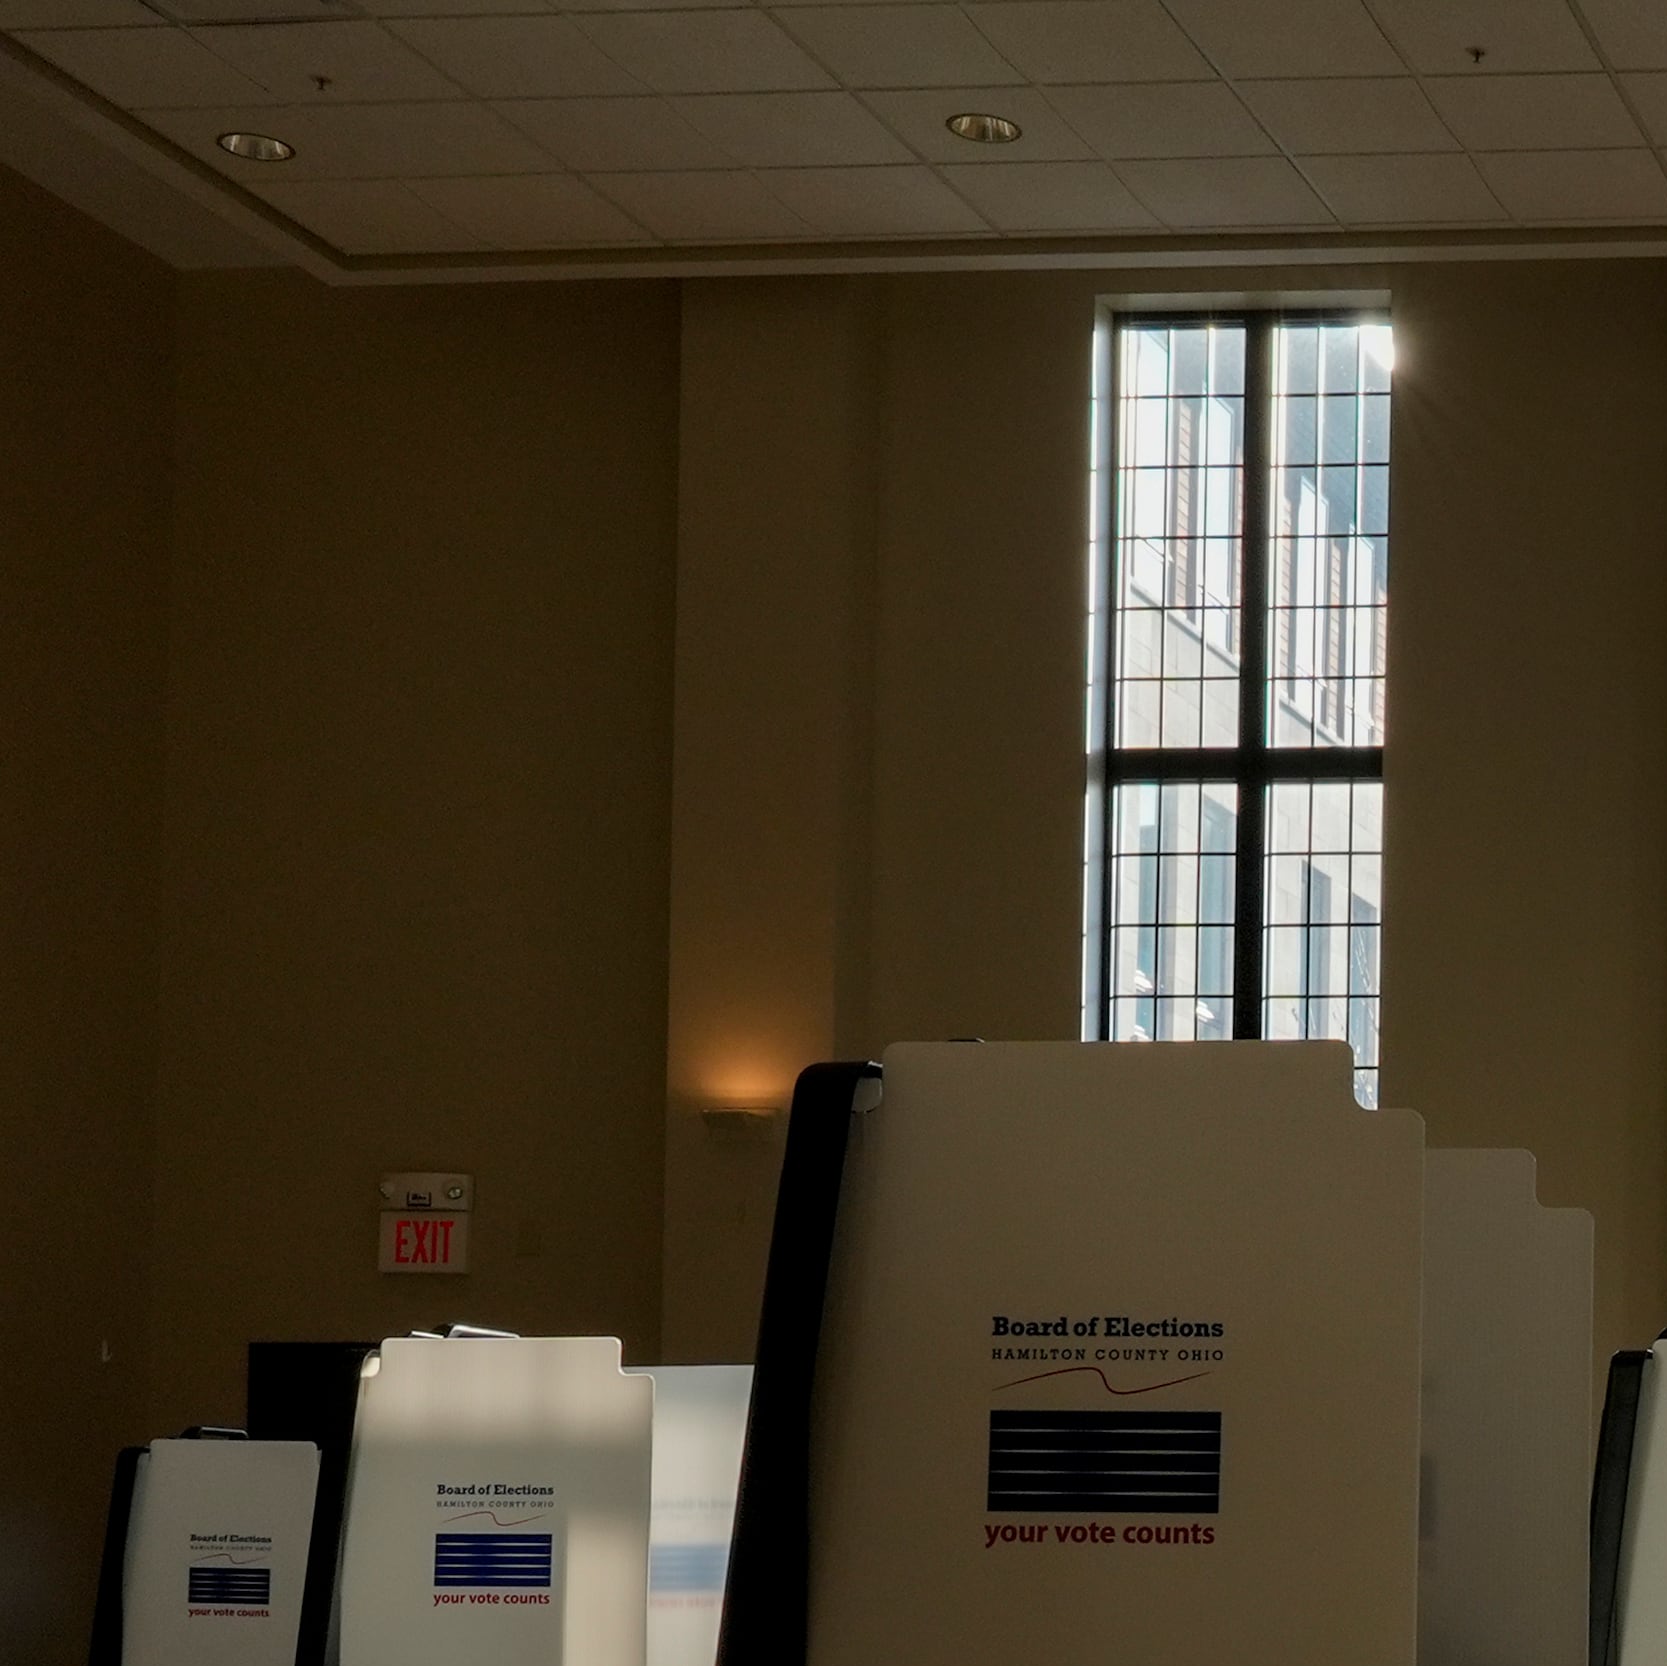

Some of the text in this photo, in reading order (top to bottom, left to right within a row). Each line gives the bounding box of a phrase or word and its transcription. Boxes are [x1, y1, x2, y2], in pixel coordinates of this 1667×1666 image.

[395, 1221, 454, 1264] EXIT
[992, 1317, 1224, 1337] Board of Elections
[992, 1349, 1224, 1361] HAMILTON COUNTY OHIO
[437, 1484, 554, 1495] Board of Elections
[985, 1522, 1215, 1548] your vote counts
[433, 1593, 550, 1607] your vote counts
[188, 1608, 269, 1618] your vote counts
